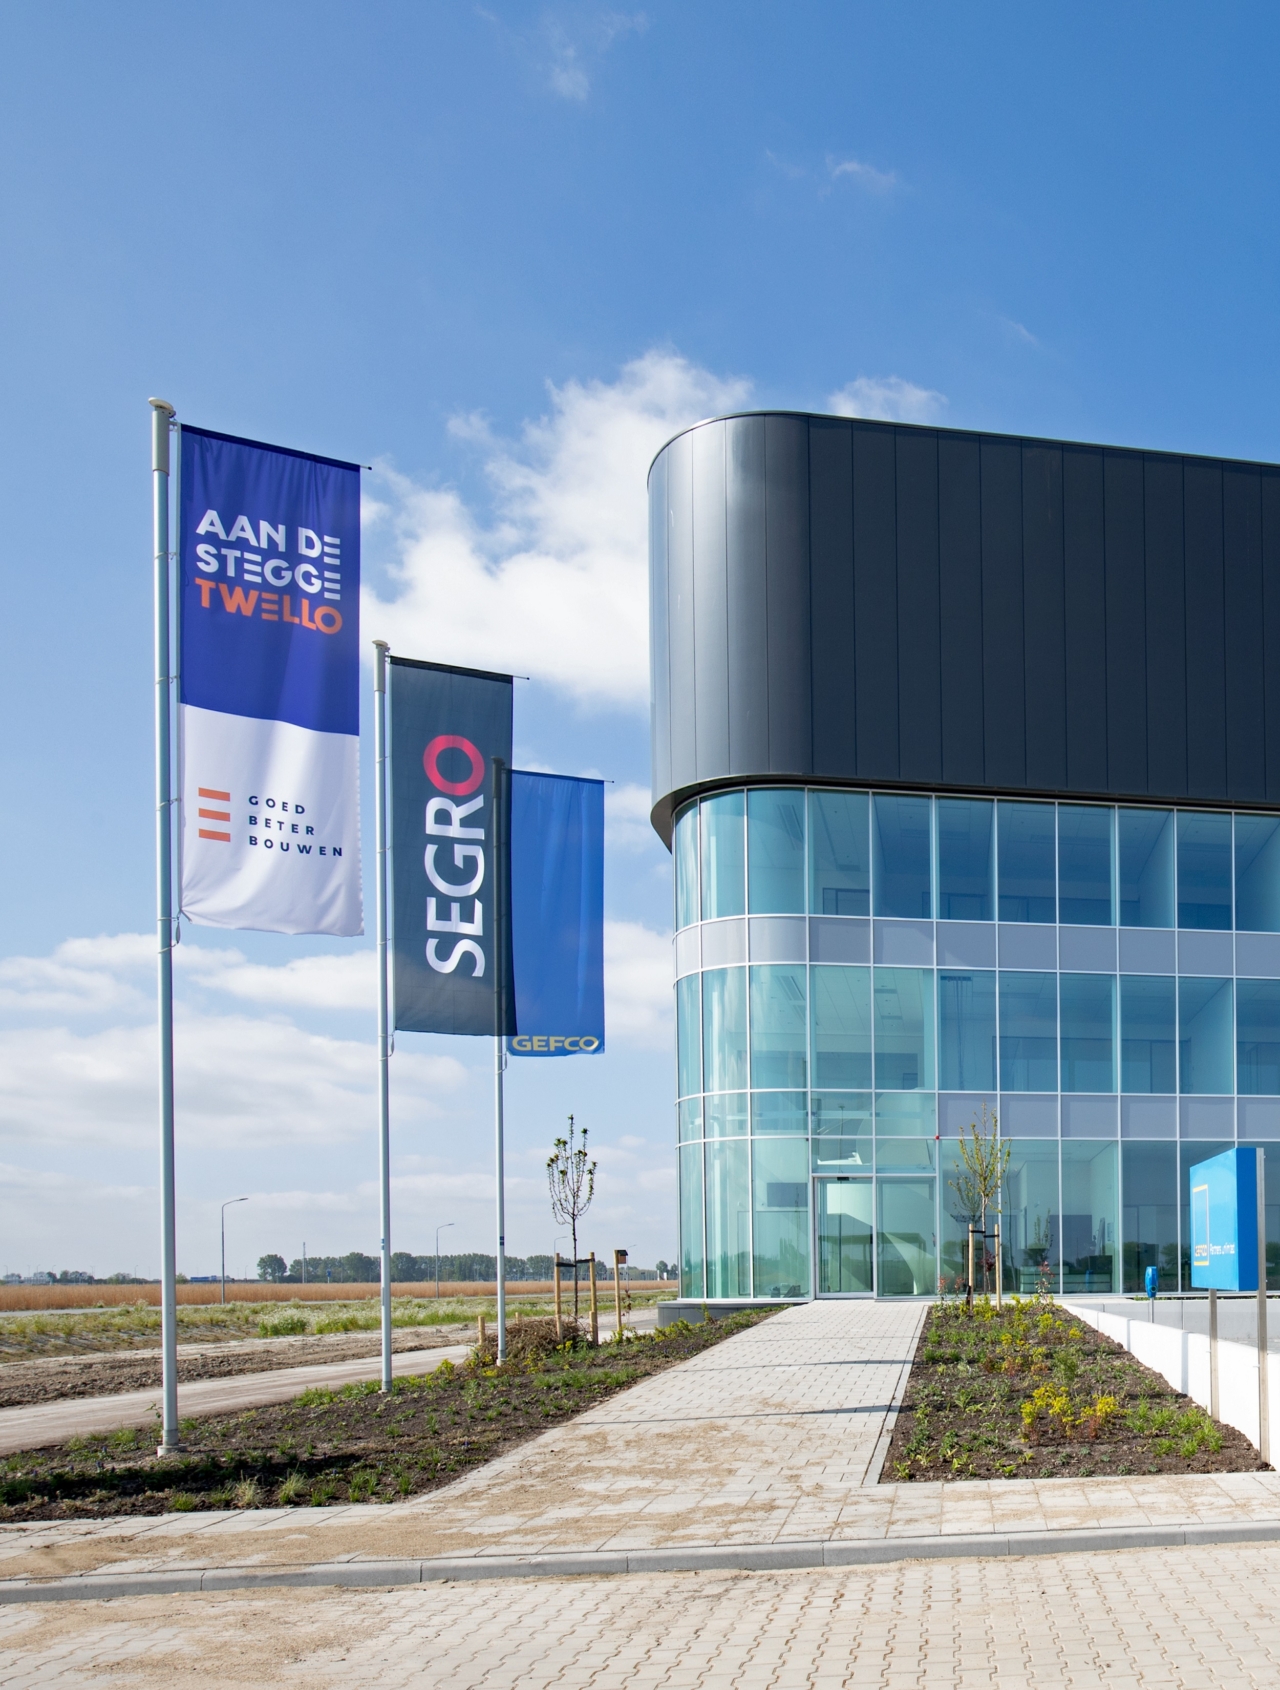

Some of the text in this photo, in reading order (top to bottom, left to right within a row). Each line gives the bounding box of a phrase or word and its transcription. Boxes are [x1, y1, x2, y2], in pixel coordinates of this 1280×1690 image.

[195, 509, 341, 566] AAN DE
[195, 543, 341, 600] STEGGE
[195, 577, 343, 635] TWELLO
[248, 795, 306, 815] GOED
[248, 815, 315, 836] BETER
[249, 835, 343, 857] BOUWEN
[423, 734, 486, 977] SEGRO
[512, 1035, 599, 1051] GEFCO
